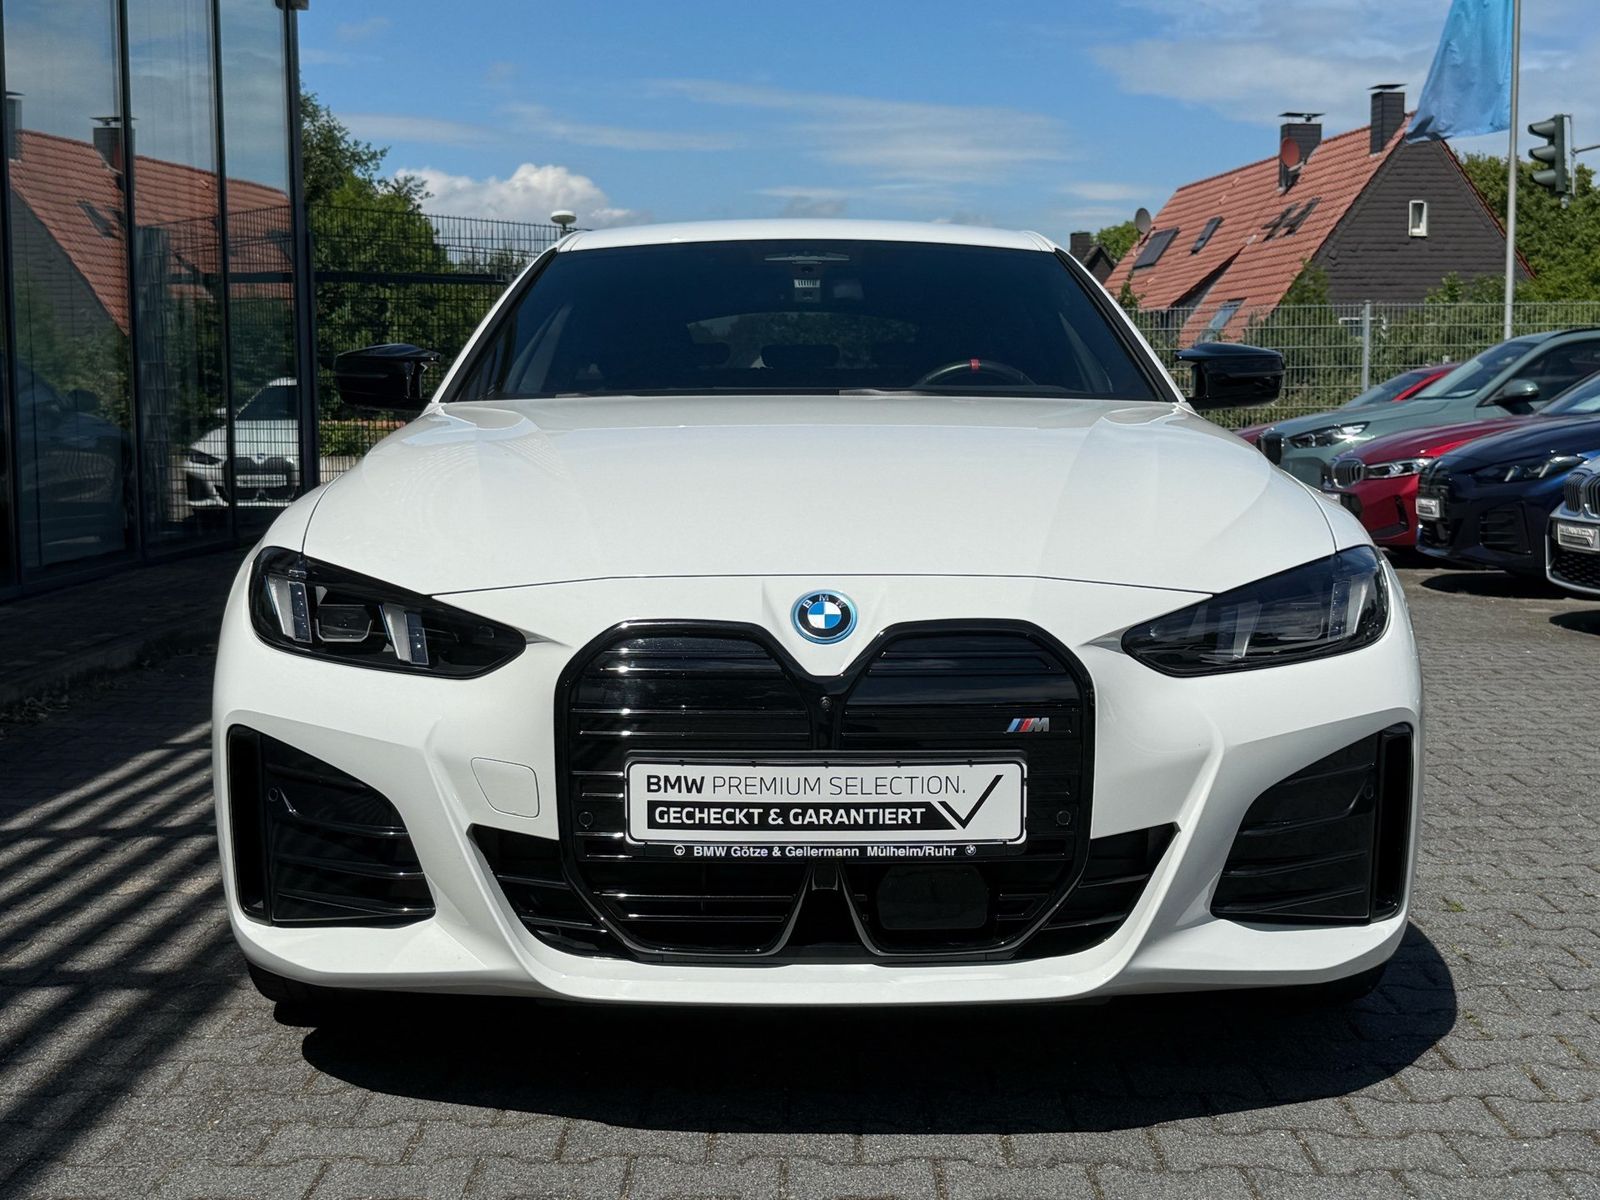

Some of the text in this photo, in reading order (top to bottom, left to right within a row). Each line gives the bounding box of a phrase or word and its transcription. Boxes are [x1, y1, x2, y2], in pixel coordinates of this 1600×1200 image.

[802, 593, 847, 609] BMW
[646, 774, 966, 796] BMW PREMIUM SELECTION.
[654, 806, 926, 825] GECHECKT & GARANTIERT
[693, 845, 957, 858] BMW Götze & Gellermann Mülheim/Ruhr
